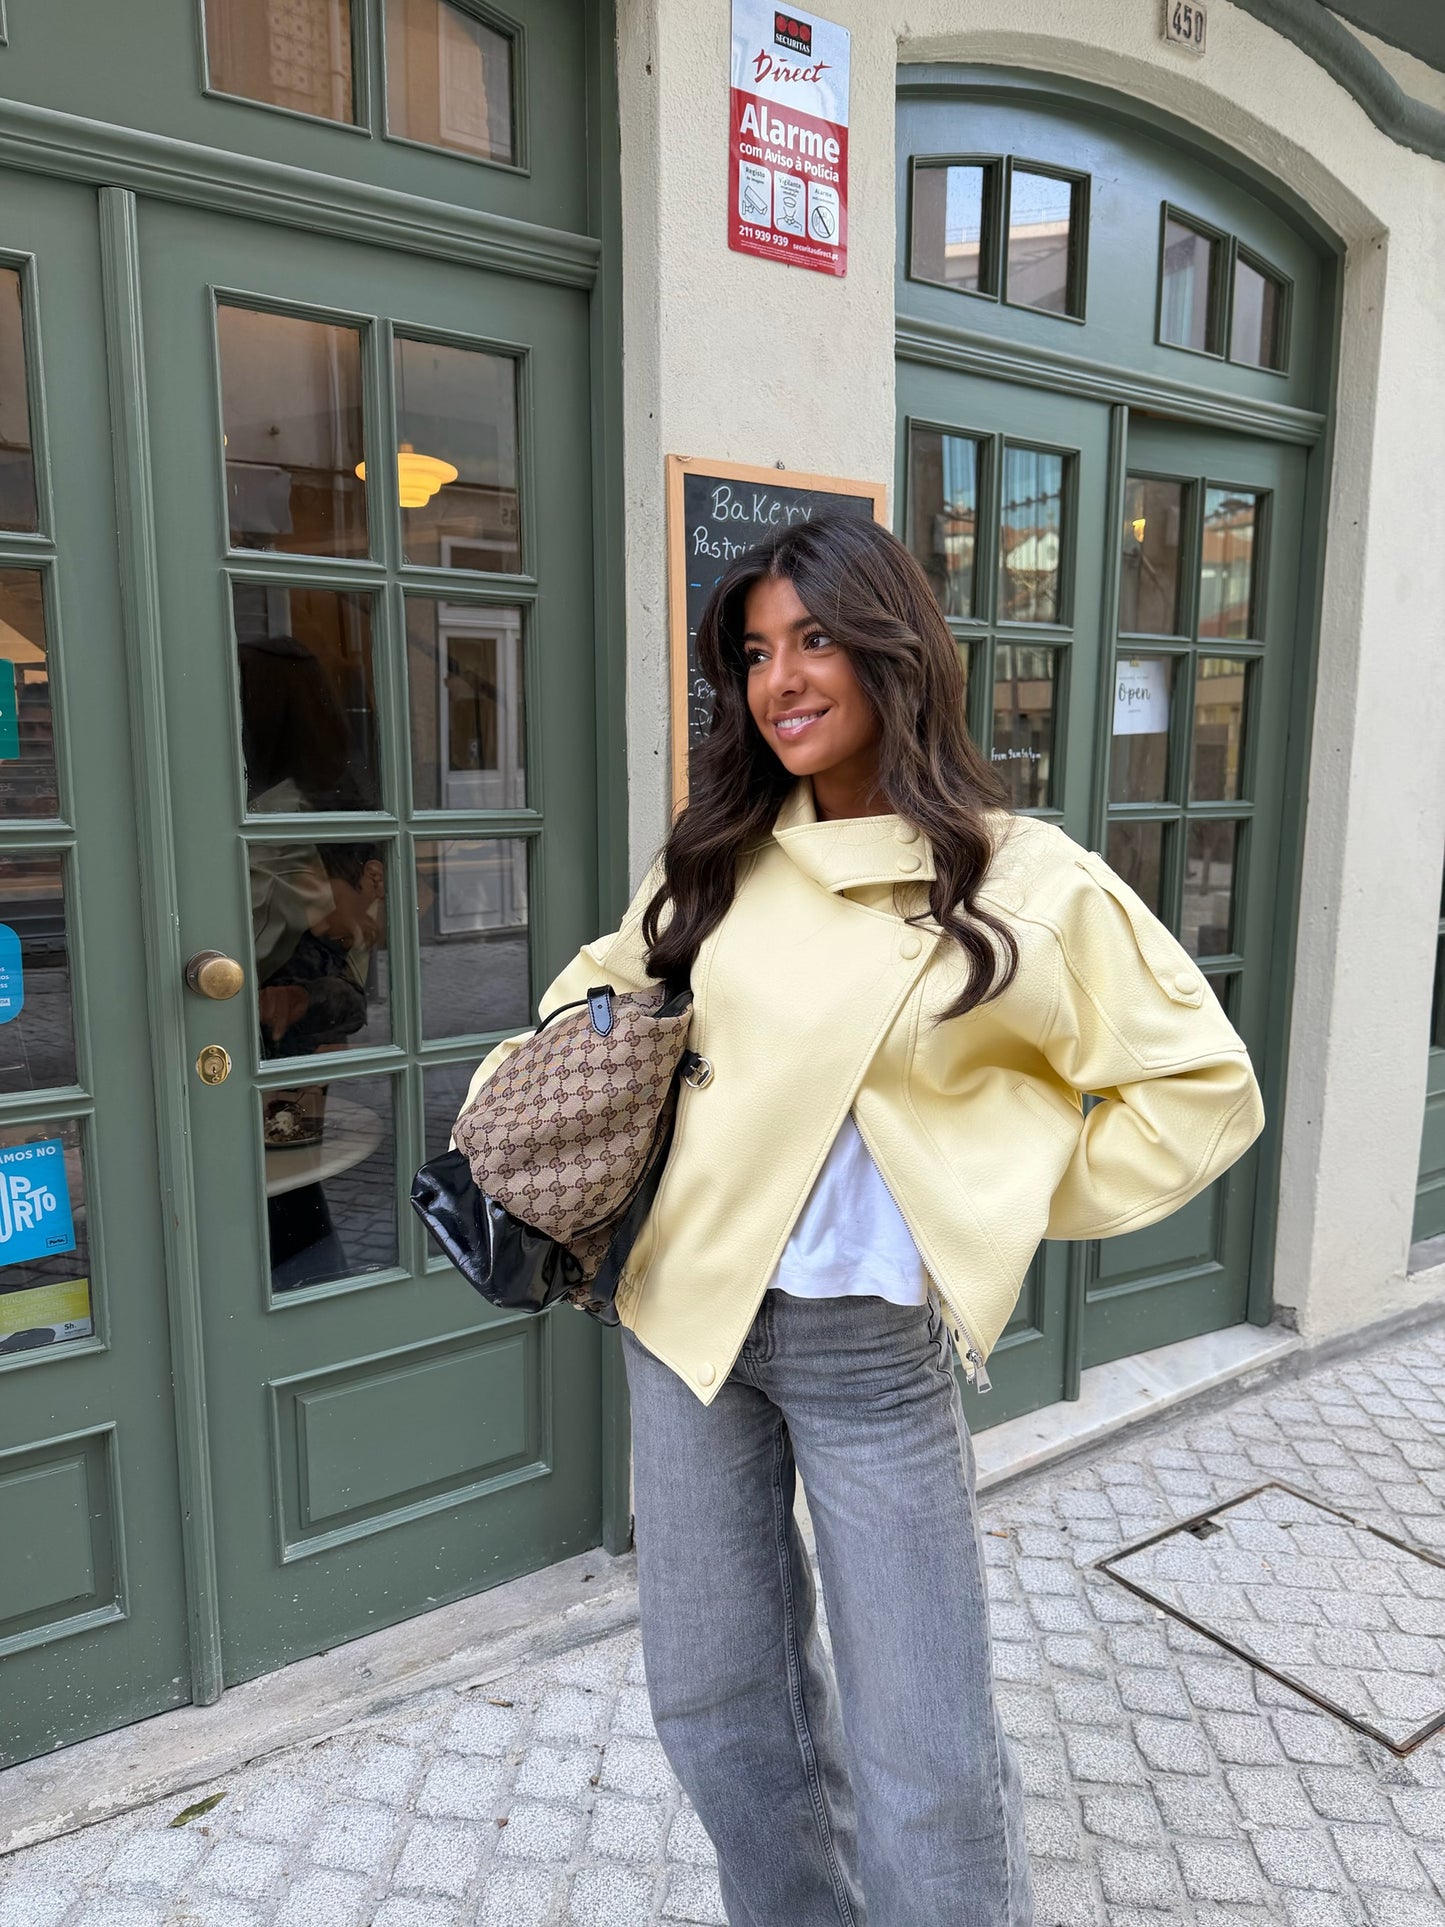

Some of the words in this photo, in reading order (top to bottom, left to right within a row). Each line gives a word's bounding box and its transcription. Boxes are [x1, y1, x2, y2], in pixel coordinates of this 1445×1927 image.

[1173, 1, 1203, 42] 450
[775, 33, 810, 54] SECURITAS
[752, 48, 832, 83] Direct
[740, 103, 840, 164] Alarme
[739, 142, 763, 158] com
[764, 148, 793, 168] Aviso
[795, 156, 802, 171] à
[804, 160, 839, 183] Polícia
[739, 225, 753, 238] 211
[755, 229, 771, 242] 939
[772, 234, 789, 247] 939
[792, 243, 839, 260] securitasdirect.pt
[1118, 682, 1151, 706] Open
[36, 1146, 56, 1157] NO
